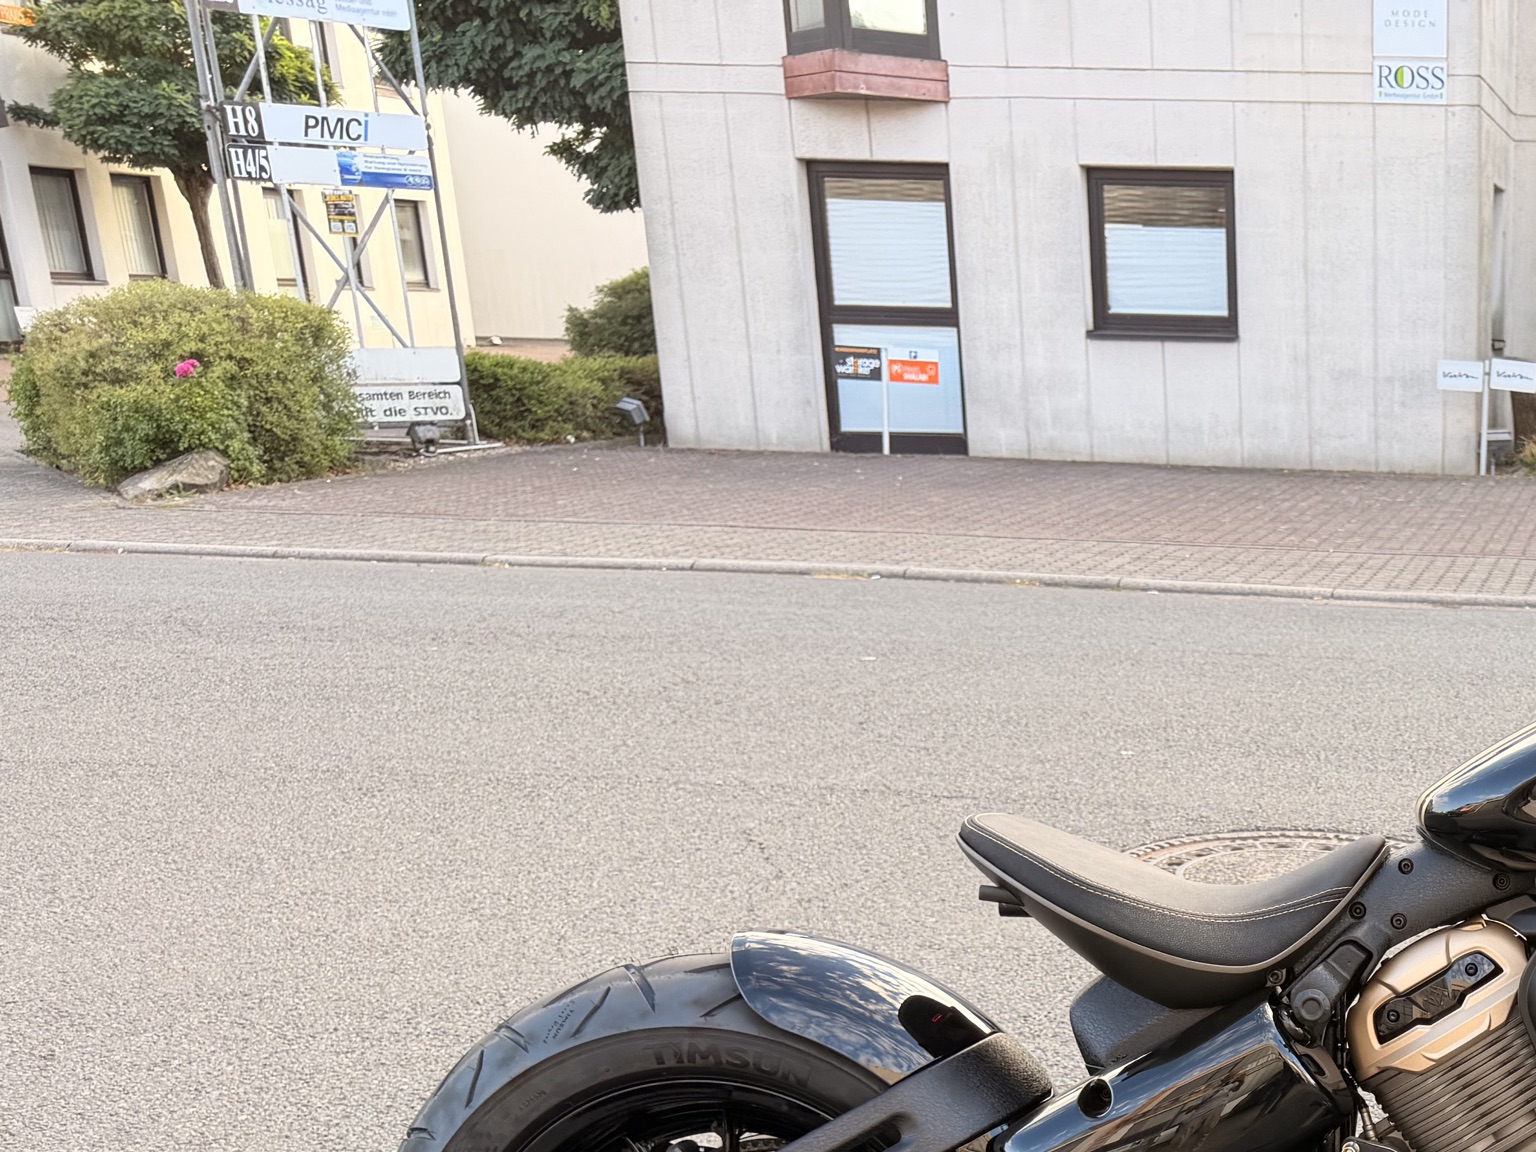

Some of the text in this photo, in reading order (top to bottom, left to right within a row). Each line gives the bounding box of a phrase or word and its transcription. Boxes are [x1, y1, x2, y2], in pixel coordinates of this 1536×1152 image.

[1391, 9, 1428, 18] MODE
[1383, 19, 1436, 28] DESIGN
[1377, 65, 1445, 91] ROSS
[223, 104, 260, 138] H8
[229, 147, 271, 180] H4/5
[408, 389, 451, 400] Bereich
[383, 407, 407, 417] die
[413, 405, 453, 417] STVO.
[646, 1041, 813, 1089] TIMSUN
